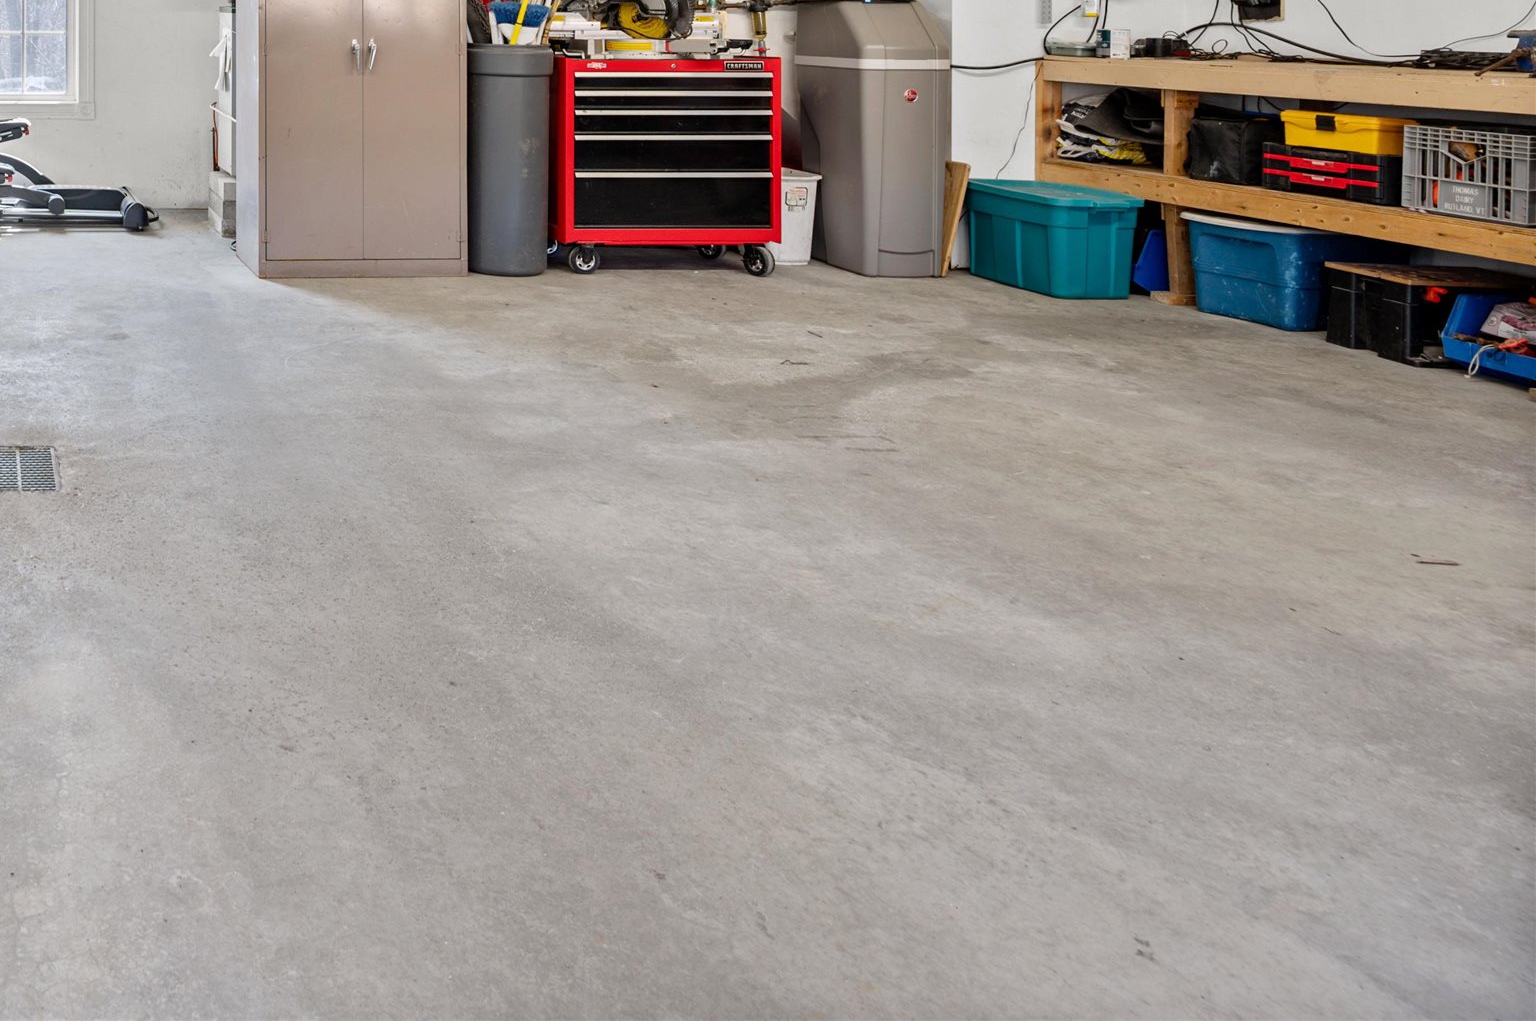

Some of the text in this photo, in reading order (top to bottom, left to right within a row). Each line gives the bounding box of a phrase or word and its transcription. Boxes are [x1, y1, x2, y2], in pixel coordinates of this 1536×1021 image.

[1452, 185, 1479, 196] THOMAS
[1455, 195, 1473, 203] DAIRY
[1476, 207, 1485, 215] VT
